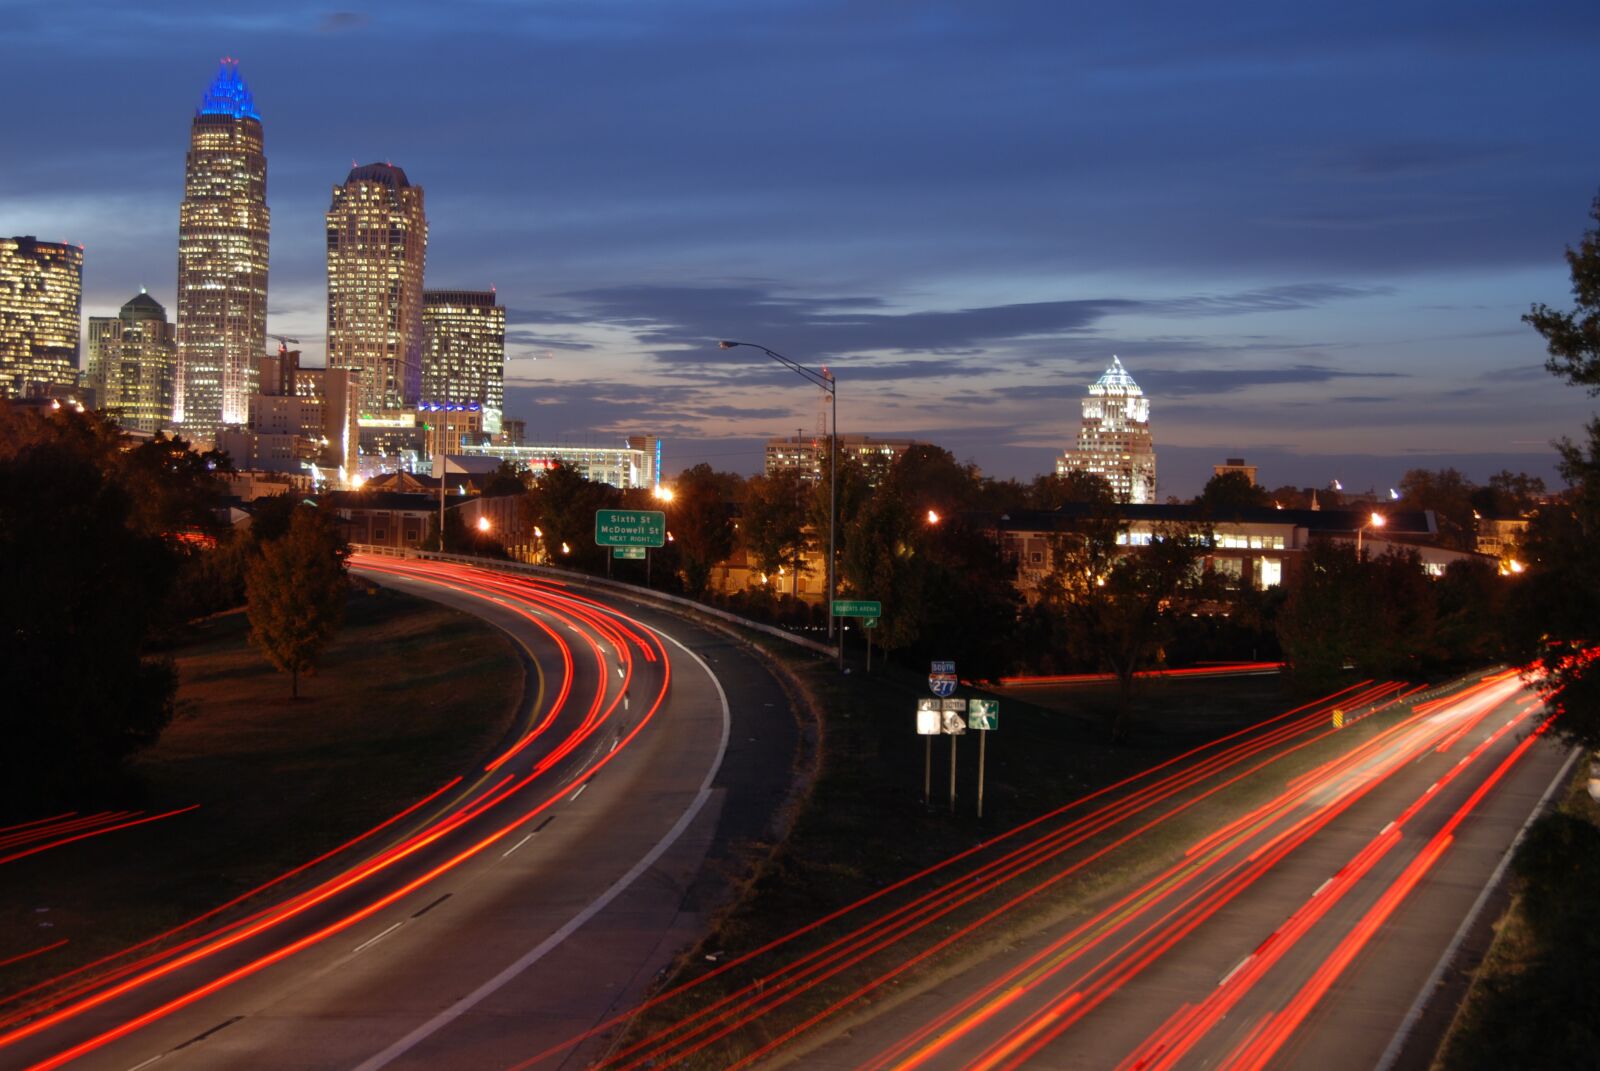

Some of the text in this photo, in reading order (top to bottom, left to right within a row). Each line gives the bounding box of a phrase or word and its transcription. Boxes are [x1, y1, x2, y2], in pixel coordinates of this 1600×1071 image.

[611, 515, 636, 523] Sixth
[601, 526, 645, 534] McDowell
[933, 664, 954, 672] SOUTH
[934, 680, 955, 691] 277
